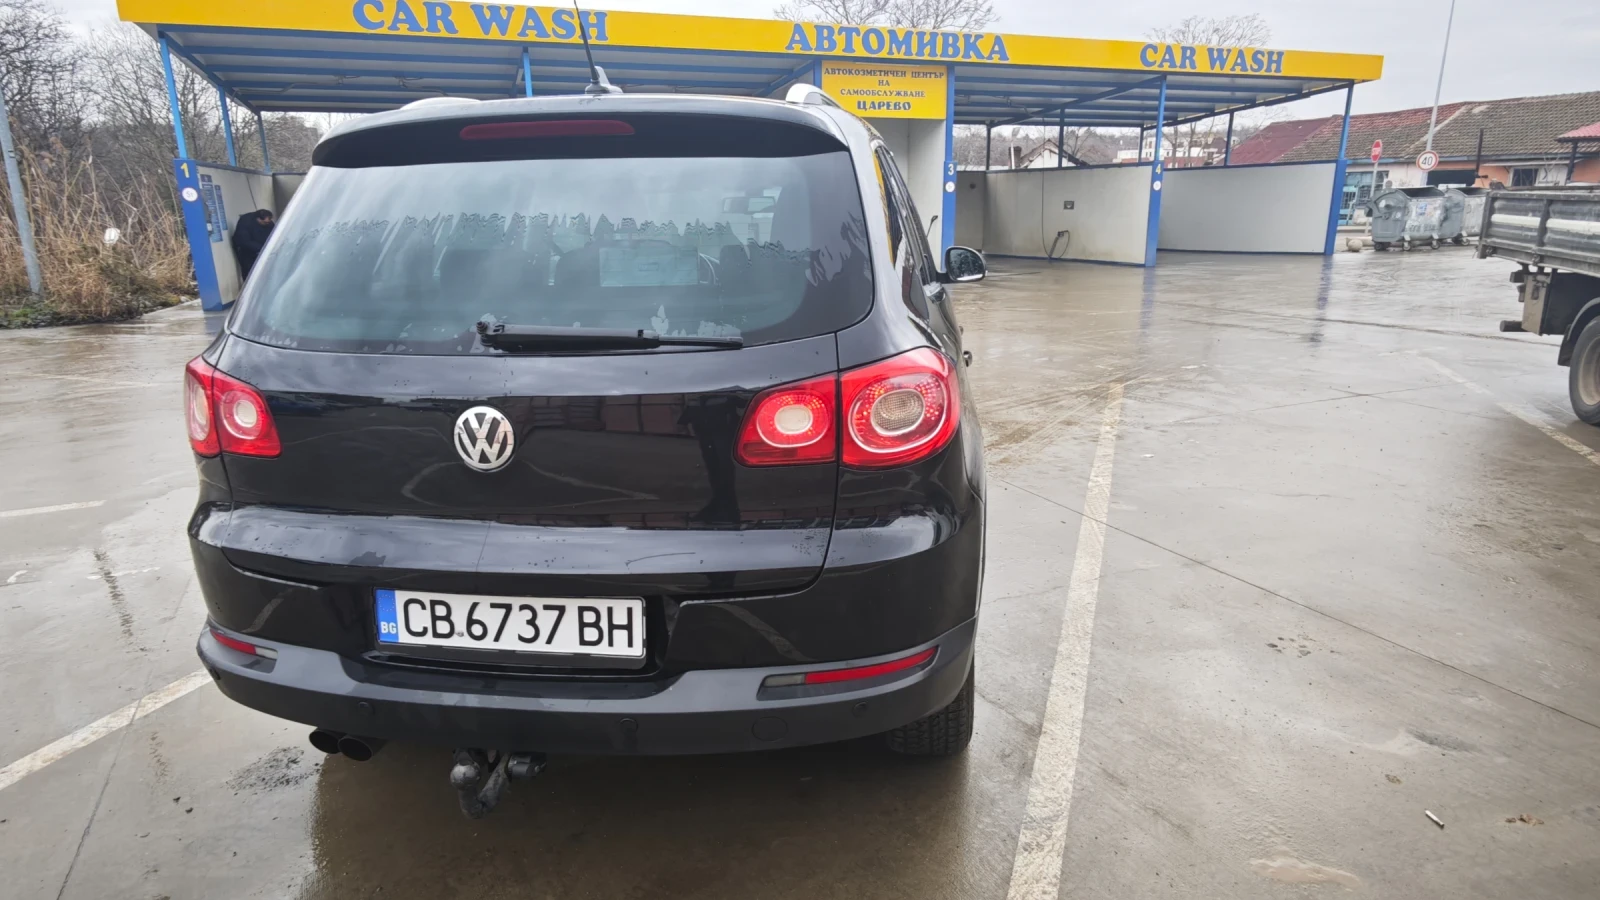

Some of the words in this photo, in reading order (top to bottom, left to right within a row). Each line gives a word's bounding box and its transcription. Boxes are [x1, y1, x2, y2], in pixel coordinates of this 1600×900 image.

[352, 0, 459, 35] CAR
[470, 4, 608, 42] WASH
[785, 23, 1010, 61] АВТОМИВКА
[1140, 43, 1197, 69] CAR
[1206, 47, 1284, 73] WASH
[824, 67, 907, 78] АВТОКОЗМЕТИЧЕН
[911, 71, 944, 79] ЦЕНТЪР
[878, 79, 890, 87] НА
[840, 88, 926, 98] САМООБСЛУЖВАНЕ
[857, 100, 911, 111] ЦАРЕВО
[1421, 156, 1434, 167] 40
[180, 162, 190, 179] 1
[947, 163, 955, 176] 3
[1155, 163, 1161, 175] 4
[380, 621, 397, 634] BG
[403, 597, 455, 639] CB
[465, 601, 567, 645] 6737
[577, 605, 634, 648] BH
